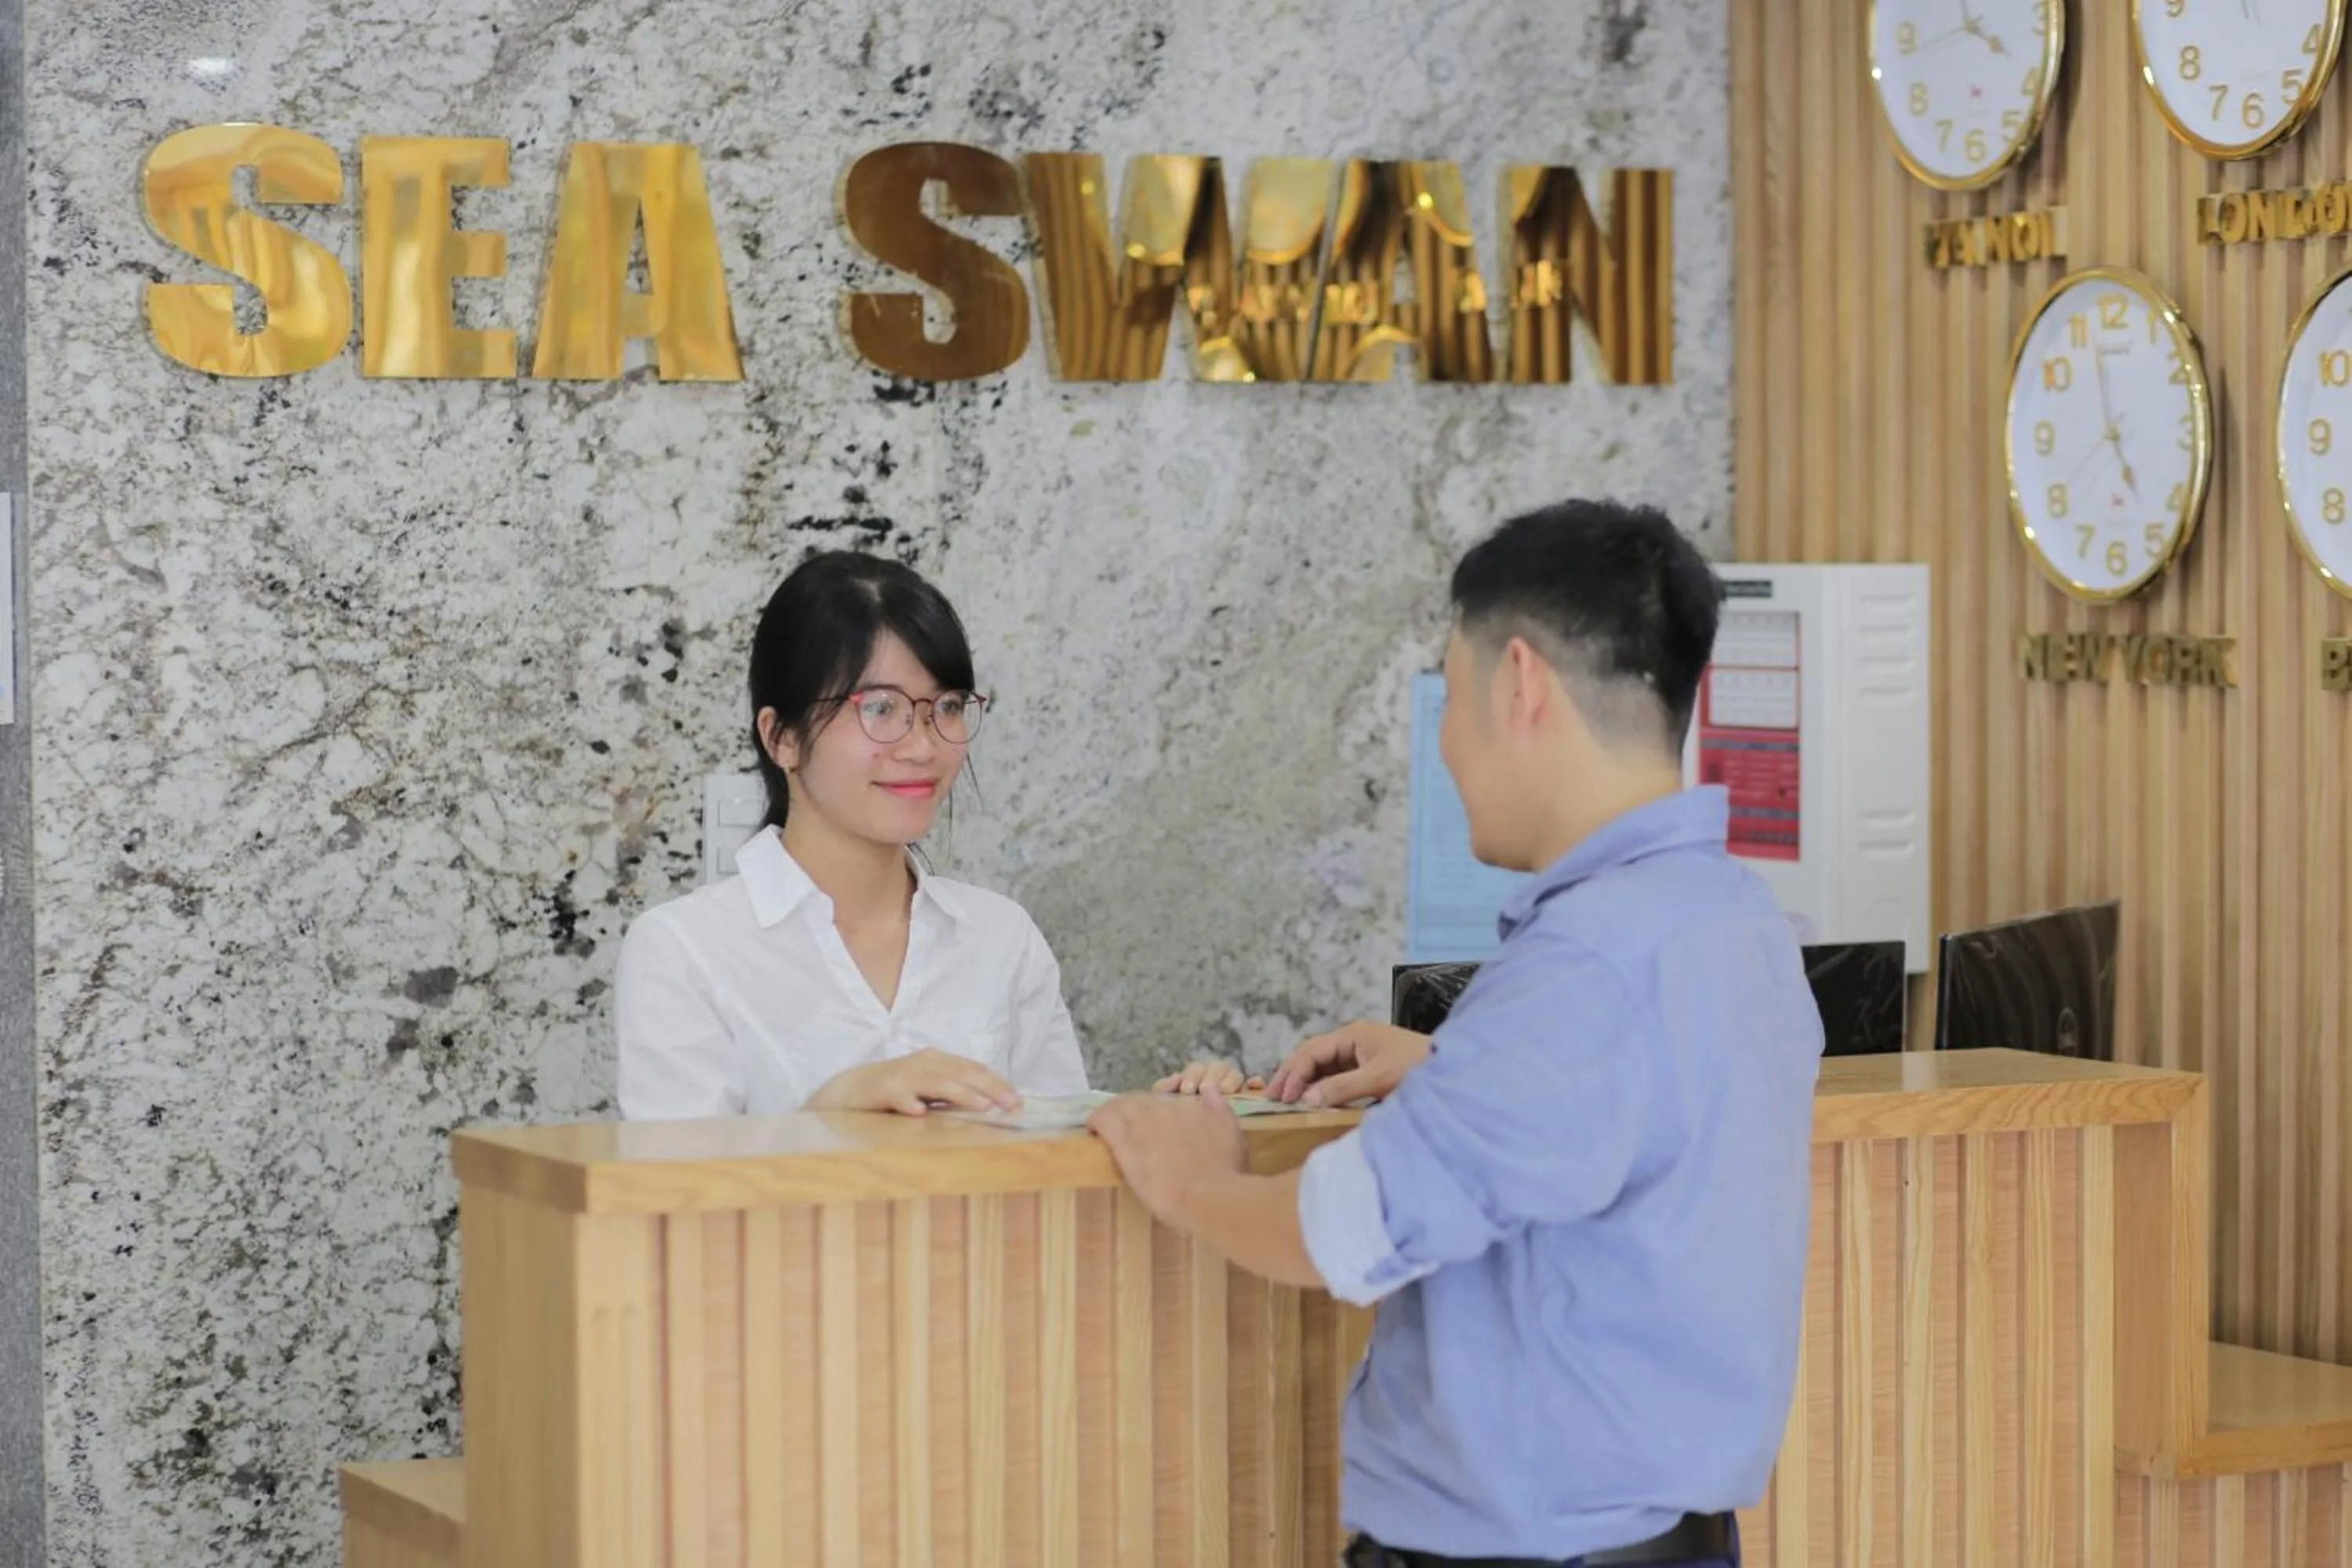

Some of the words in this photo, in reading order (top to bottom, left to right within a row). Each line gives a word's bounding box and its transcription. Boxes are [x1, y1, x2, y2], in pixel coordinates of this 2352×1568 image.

[1896, 21, 1918, 56] 9
[2180, 45, 2201, 81] 8
[1909, 82, 1929, 117] 8
[2209, 83, 2229, 121] 7
[2281, 68, 2303, 105] 5
[2002, 109, 2022, 143] 5
[2242, 92, 2266, 129] 6
[1934, 118, 1954, 154] 7
[1964, 127, 1987, 163] 6
[143, 122, 746, 382] SEA
[842, 141, 1674, 384] SWAN
[2099, 293, 2129, 330] 12
[2068, 314, 2088, 349] 11
[2043, 356, 2072, 392] 10
[2167, 350, 2188, 385] 2
[2318, 349, 2352, 387] 10
[2034, 421, 2056, 456] 9
[2308, 417, 2332, 456] 9
[2047, 483, 2069, 517] 8
[2321, 487, 2346, 524] 8
[2075, 523, 2096, 560] 7
[2106, 540, 2129, 576] 6
[2144, 522, 2165, 558] 5
